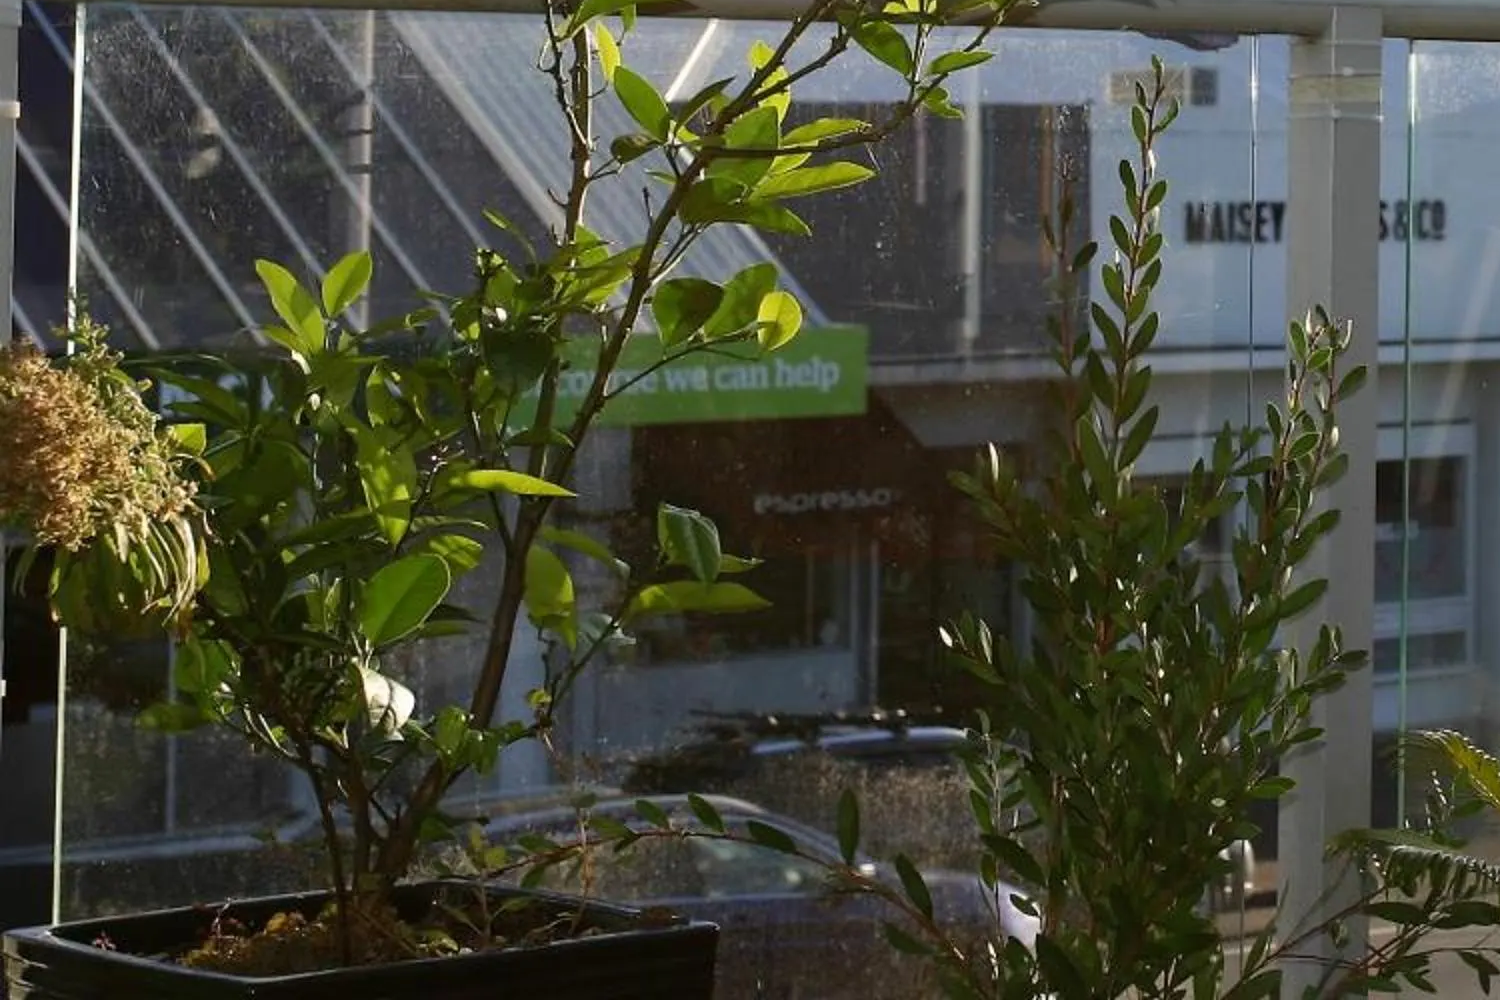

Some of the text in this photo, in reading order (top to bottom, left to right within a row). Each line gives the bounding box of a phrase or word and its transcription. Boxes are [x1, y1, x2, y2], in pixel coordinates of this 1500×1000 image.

[1184, 201, 1286, 243] MAISEY
[664, 366, 708, 392] we
[714, 363, 769, 391] can
[774, 357, 839, 393] help
